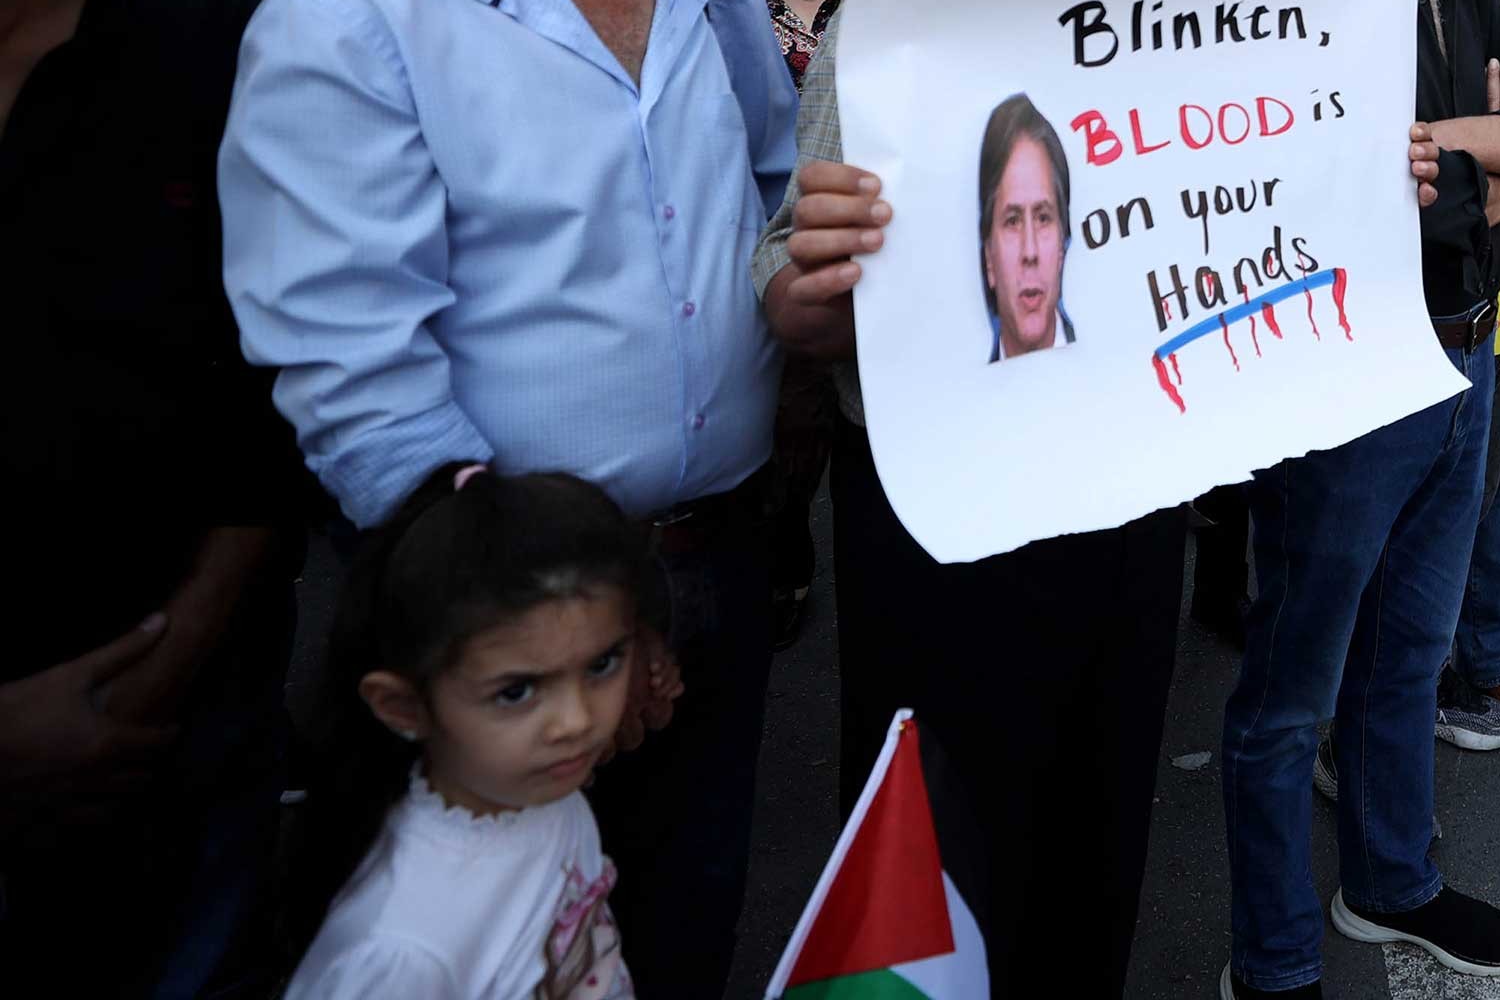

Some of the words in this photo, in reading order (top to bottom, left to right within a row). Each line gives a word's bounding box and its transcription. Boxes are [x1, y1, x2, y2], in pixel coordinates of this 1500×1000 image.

[1070, 96, 1295, 167] BLOOD
[1311, 88, 1346, 123] is
[1081, 196, 1155, 251] on
[1181, 177, 1282, 254] your
[1146, 226, 1320, 332] Hands
